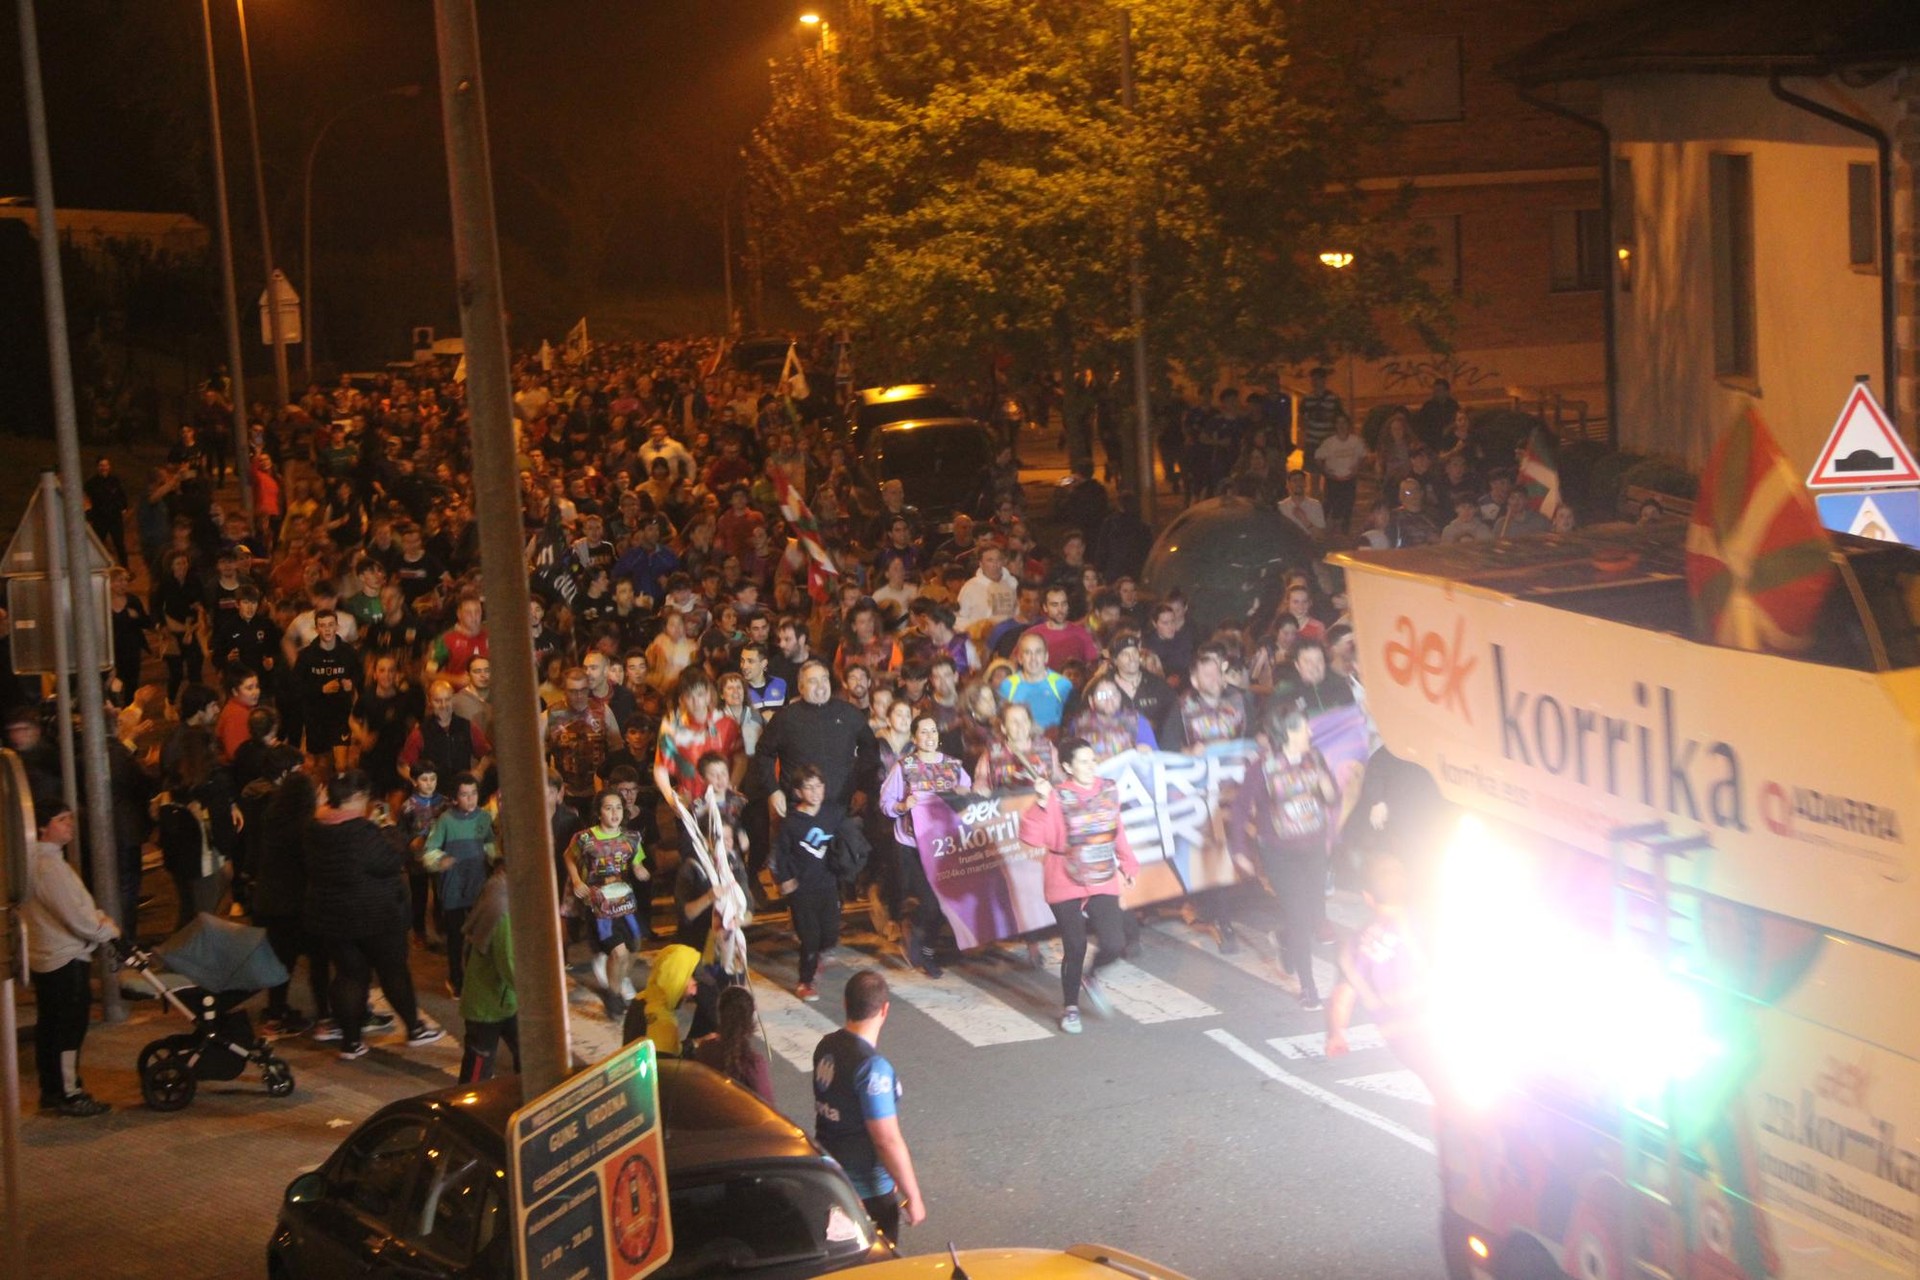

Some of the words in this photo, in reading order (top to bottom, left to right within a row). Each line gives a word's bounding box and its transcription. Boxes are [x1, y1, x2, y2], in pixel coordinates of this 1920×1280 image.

[1383, 615, 1477, 726] aek
[1491, 642, 1750, 831] korrika
[962, 798, 1001, 826] aek
